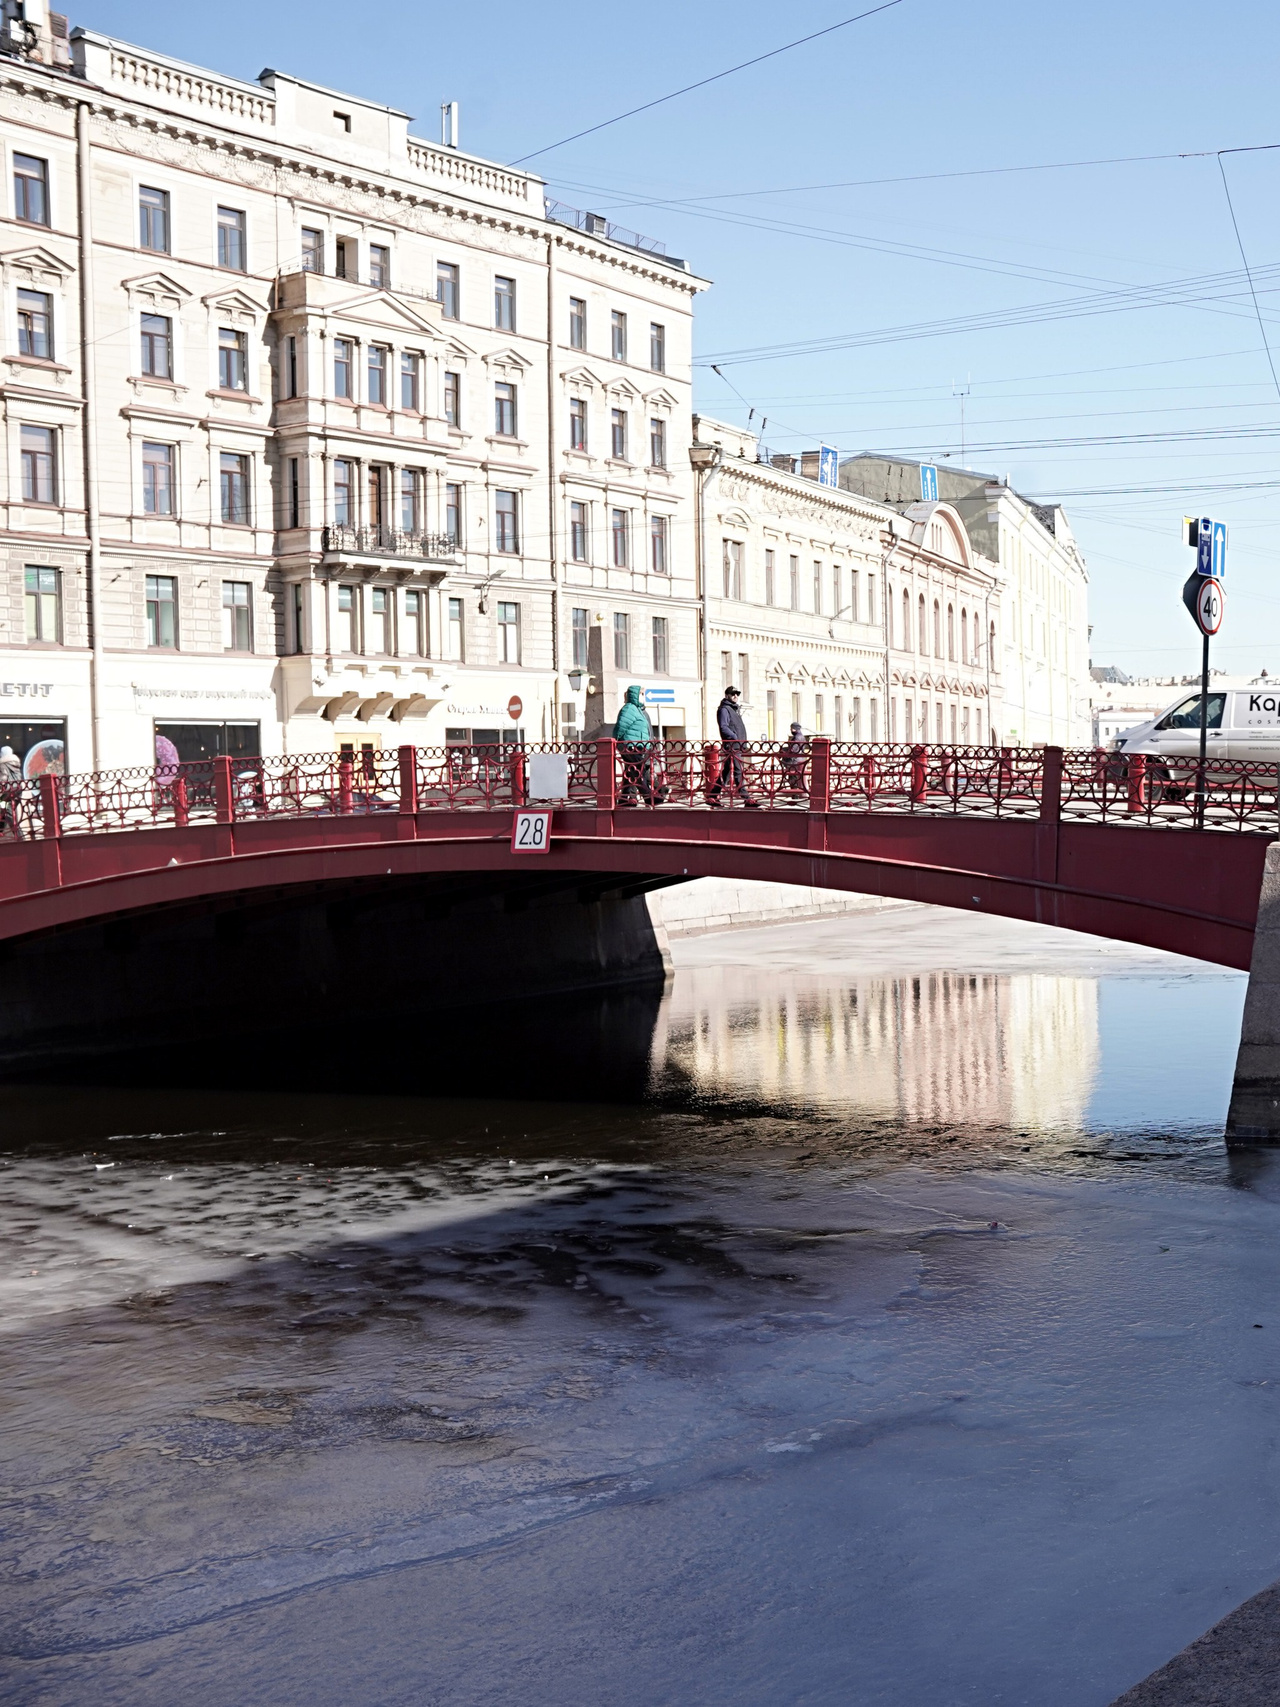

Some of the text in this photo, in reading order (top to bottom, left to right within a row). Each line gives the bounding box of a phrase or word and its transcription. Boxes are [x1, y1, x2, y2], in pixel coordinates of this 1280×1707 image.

[1203, 596, 1218, 617] 40
[2, 682, 54, 697] ETIT
[519, 817, 544, 845] 2.8
